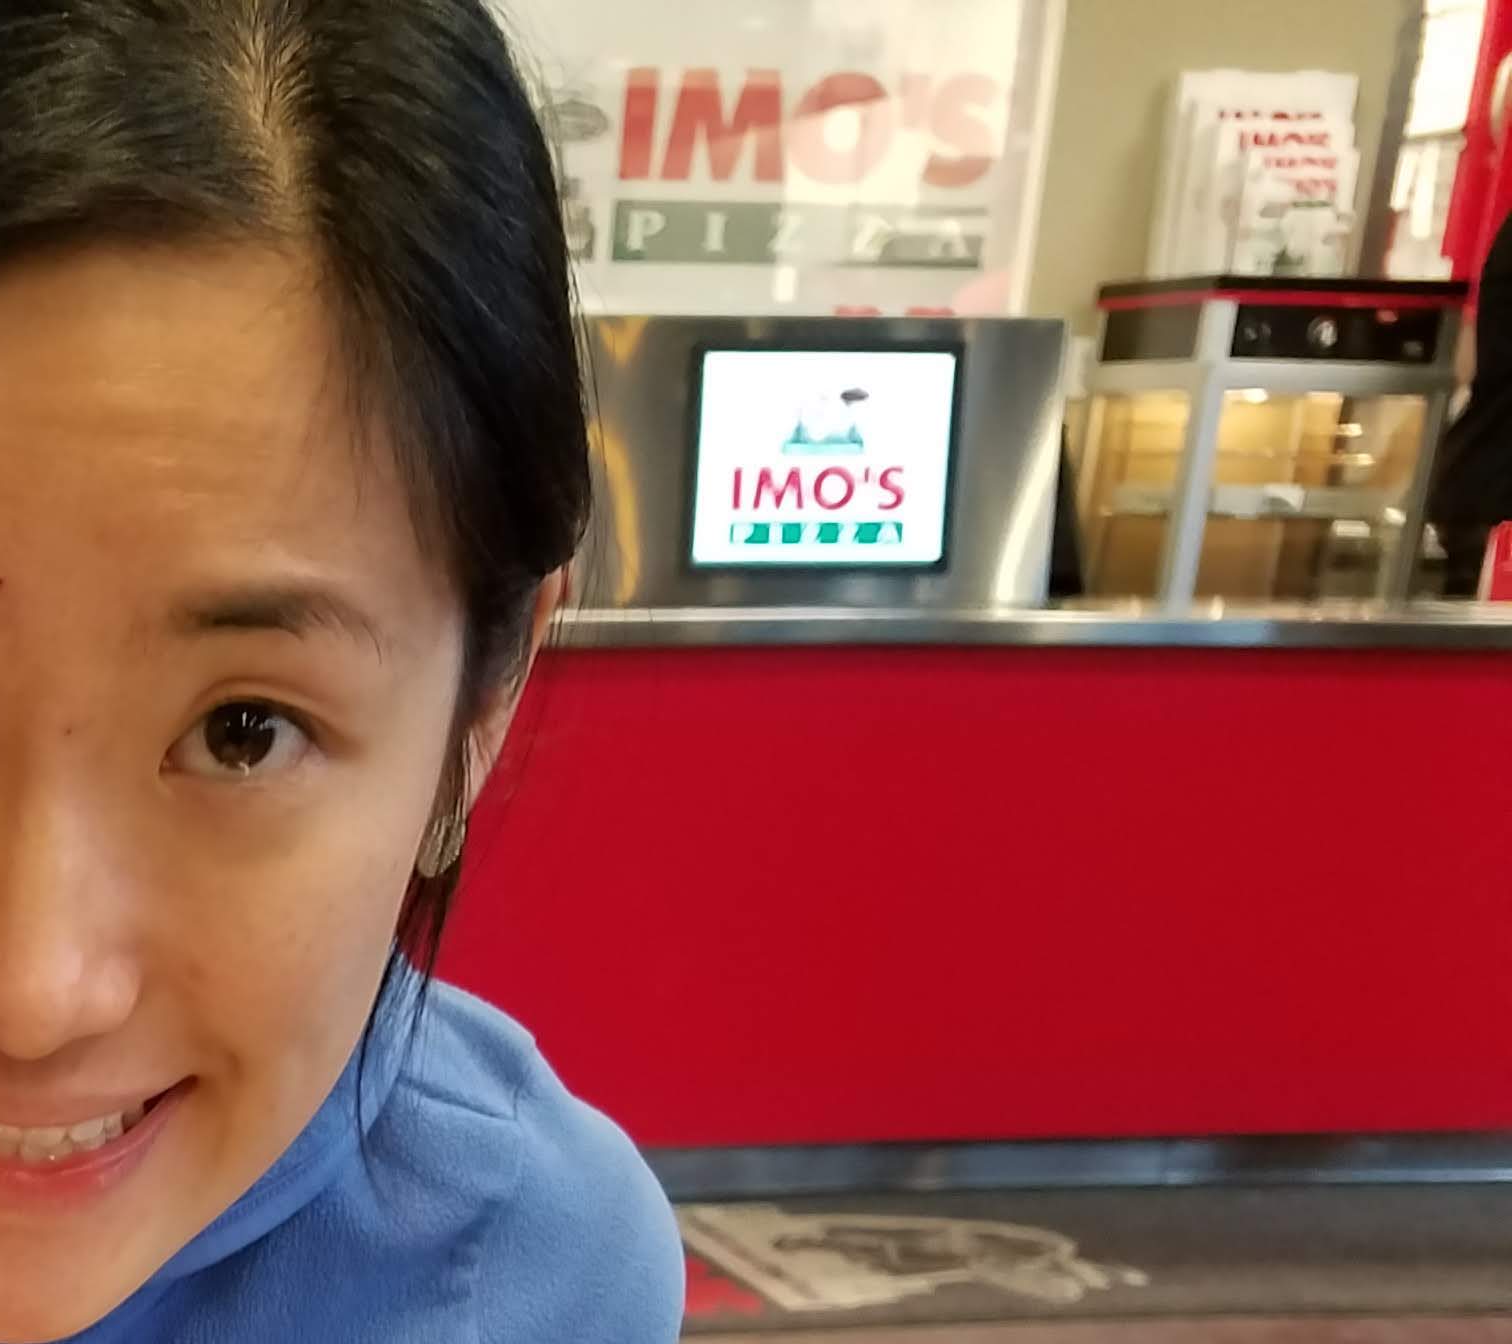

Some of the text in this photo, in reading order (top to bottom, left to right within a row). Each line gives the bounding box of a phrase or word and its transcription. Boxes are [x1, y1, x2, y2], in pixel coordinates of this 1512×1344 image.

[618, 67, 1000, 187] IMO'S
[624, 208, 972, 259] PIZZA
[731, 466, 906, 510] IMO'S
[731, 521, 902, 544] PIZZA
